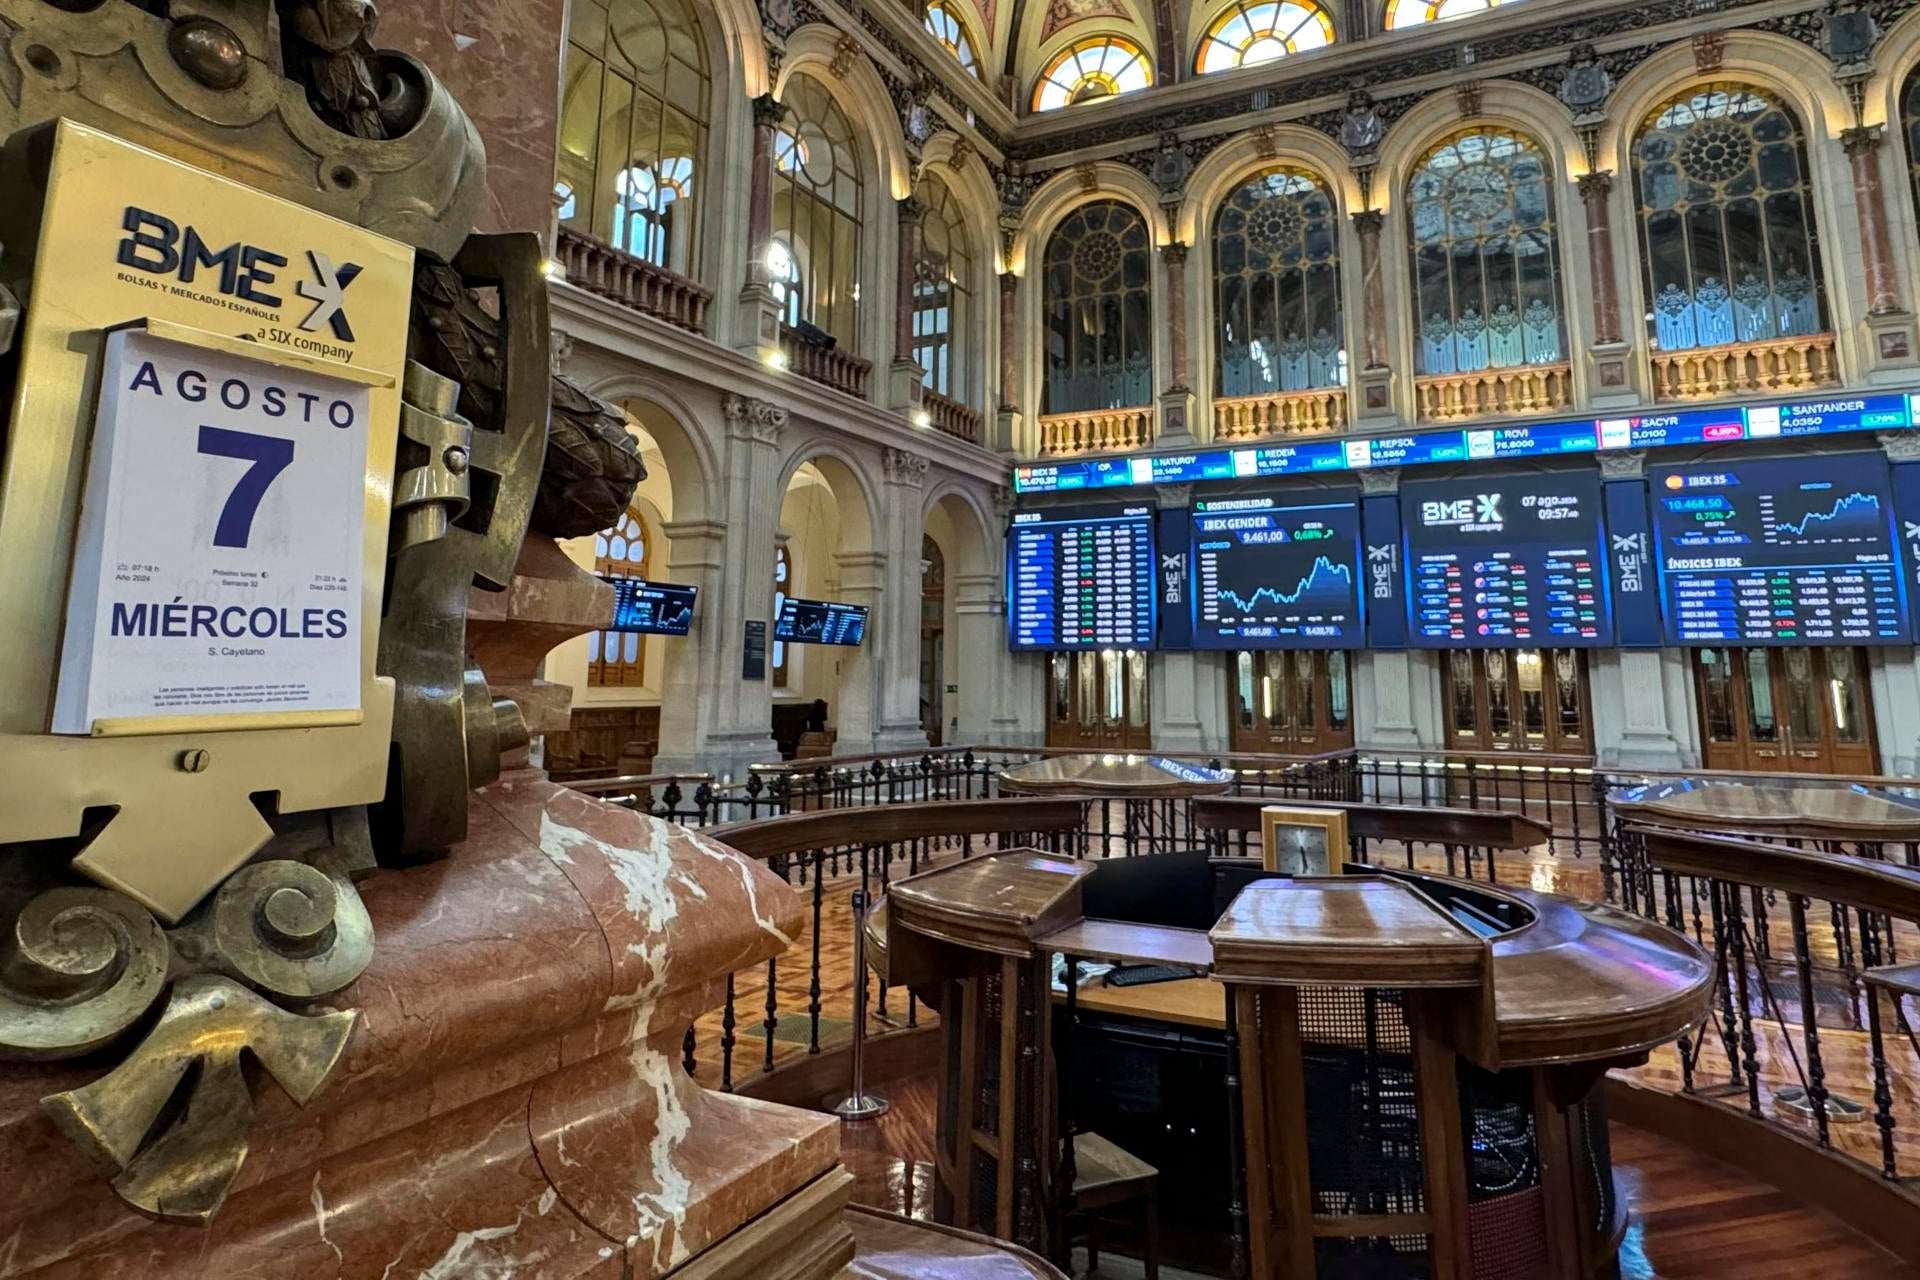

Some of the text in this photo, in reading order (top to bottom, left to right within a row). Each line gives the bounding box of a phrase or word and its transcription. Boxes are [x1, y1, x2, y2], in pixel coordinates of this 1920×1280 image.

[117, 273, 281, 322] BOLSAS Y MERCADOS ESPAÑOLES
[257, 328, 353, 364] a SIX company
[129, 361, 354, 429] AGOSTO
[1792, 401, 1865, 416] SANTANDER
[1641, 417, 1679, 428] SACYR
[1504, 429, 1529, 439] ROVI
[1380, 438, 1416, 449] REPSOL
[1265, 447, 1297, 458] REDEIA
[1159, 456, 1197, 466] NATURGY
[197, 425, 294, 548] 7
[1689, 475, 1727, 487] IBEX 35
[1206, 498, 1274, 511] SOSTENIBILIDAD
[1521, 496, 1536, 507] 07
[1203, 517, 1268, 531] IBEX GENDER
[1243, 530, 1283, 543] 9.461,00
[1667, 557, 1743, 570] ÍNDICES IBEX
[111, 596, 348, 639] MIÉRCOLES
[208, 647, 265, 657] S. Cayetano
